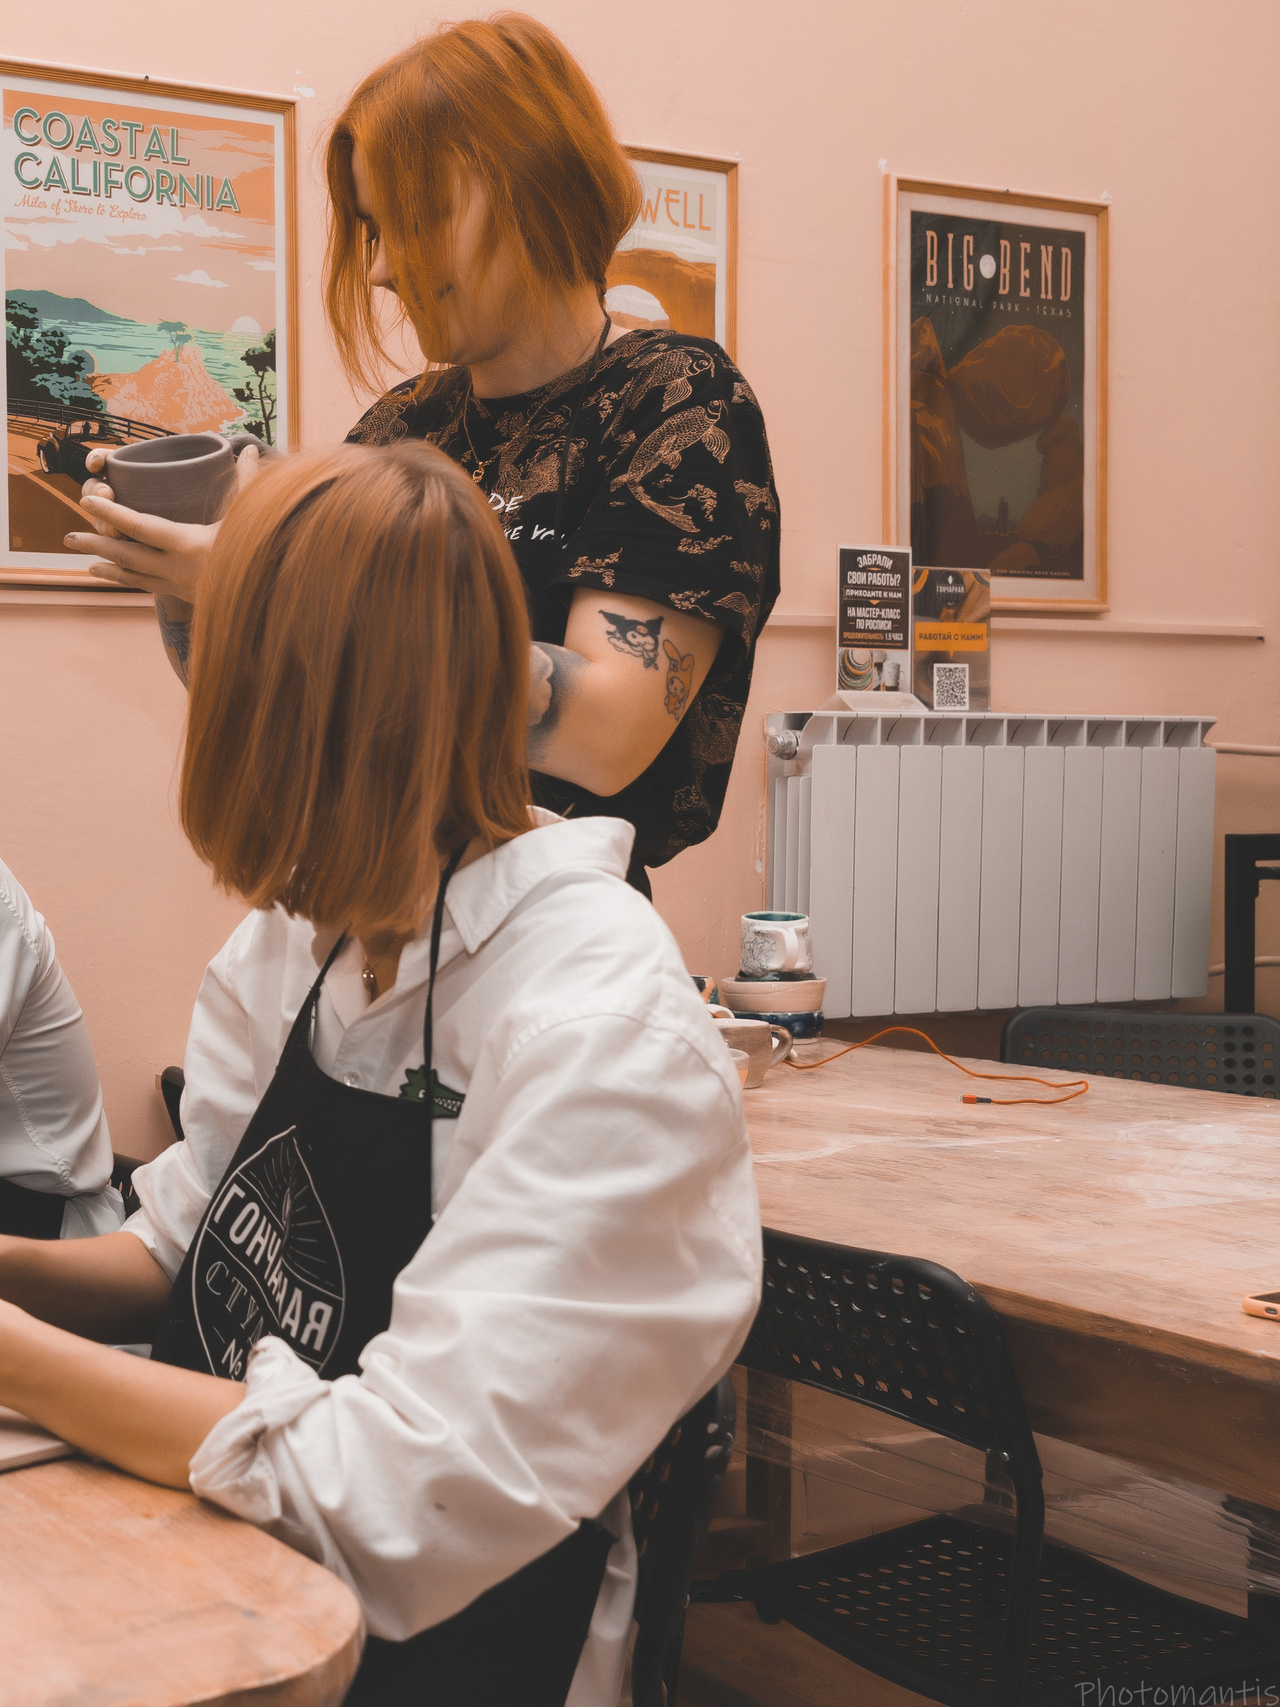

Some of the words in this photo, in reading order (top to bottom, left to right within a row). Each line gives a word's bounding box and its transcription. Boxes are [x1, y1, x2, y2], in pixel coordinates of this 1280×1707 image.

[13, 107, 189, 166] COASTAL
[13, 151, 241, 214] CALIFORNIA
[14, 194, 48, 209] Miles
[50, 198, 62, 215] of
[63, 199, 93, 215] Shore
[96, 203, 106, 216] to
[109, 204, 148, 223] Explore
[640, 187, 711, 231] WELL
[926, 230, 974, 291] BIG
[998, 239, 1072, 302] BEND
[926, 294, 984, 309] NATIONAL
[992, 301, 1020, 313] PARK
[1036, 305, 1072, 318] TEXAS
[856, 553, 893, 571] ЗАБРАЛИ
[847, 571, 867, 585] СВОИ
[867, 572, 901, 586] РАБОТЫ?
[845, 588, 882, 598] ПРИХОДИТЕ
[888, 591, 902, 599] НАМ
[847, 607, 856, 618] НА
[856, 607, 901, 620] МАСТЕР-КЛАСС
[856, 619, 865, 630] ПО
[865, 619, 892, 631] РОСПИСИ
[918, 631, 952, 641] РАБОТАЙ
[960, 634, 984, 642] НАМИ!
